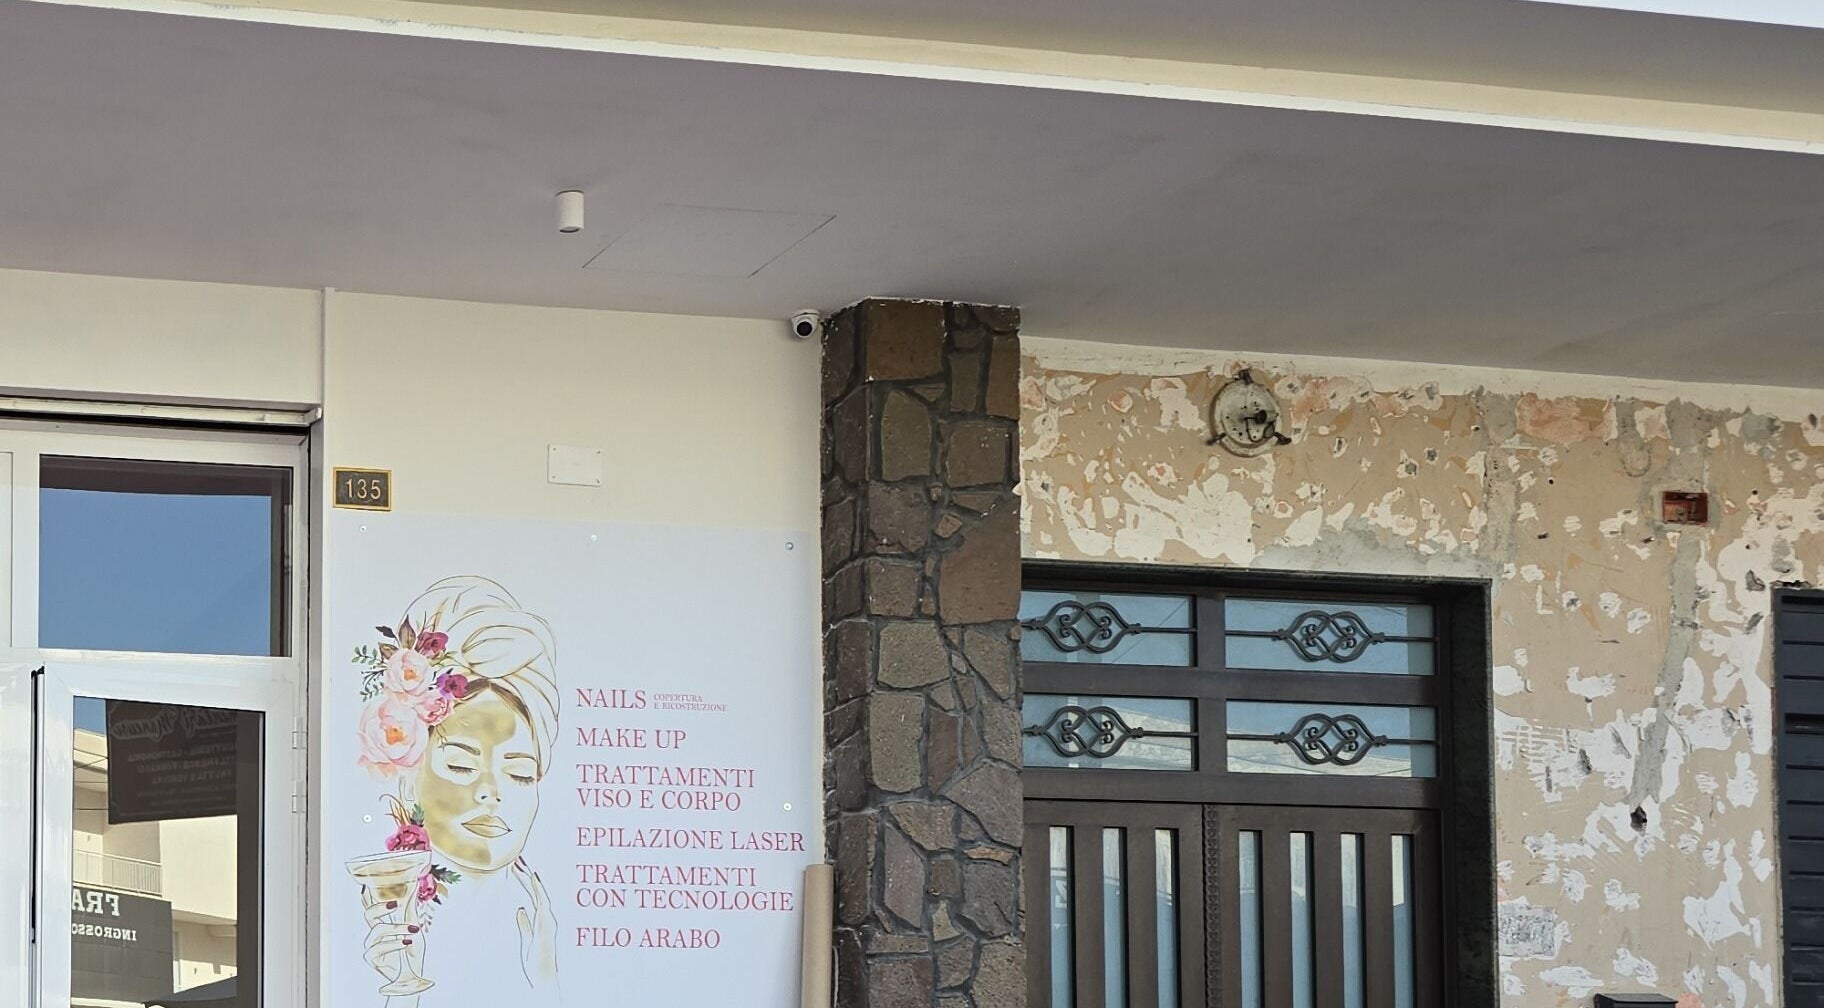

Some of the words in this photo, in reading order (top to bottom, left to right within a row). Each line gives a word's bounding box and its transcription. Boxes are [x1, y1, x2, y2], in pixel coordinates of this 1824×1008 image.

[345, 478, 382, 499] 135
[576, 688, 647, 710] NAILS
[653, 693, 703, 702] COPERTURA
[662, 703, 727, 712] RICOSTRUZIONE
[576, 727, 647, 748] MAKE
[654, 729, 687, 749] UP
[576, 764, 755, 788] TRATTAMENTI
[576, 788, 632, 808] VISO
[639, 789, 654, 809] E
[661, 790, 741, 811] CORPO
[576, 827, 723, 850] EPILAZIONE
[731, 831, 806, 852] LASER
[576, 864, 757, 887] TRATTAMENTI
[576, 888, 626, 908] CON
[634, 889, 794, 912] TECNOLOGIE
[576, 927, 631, 947] FILO
[639, 928, 721, 949] ARABO
